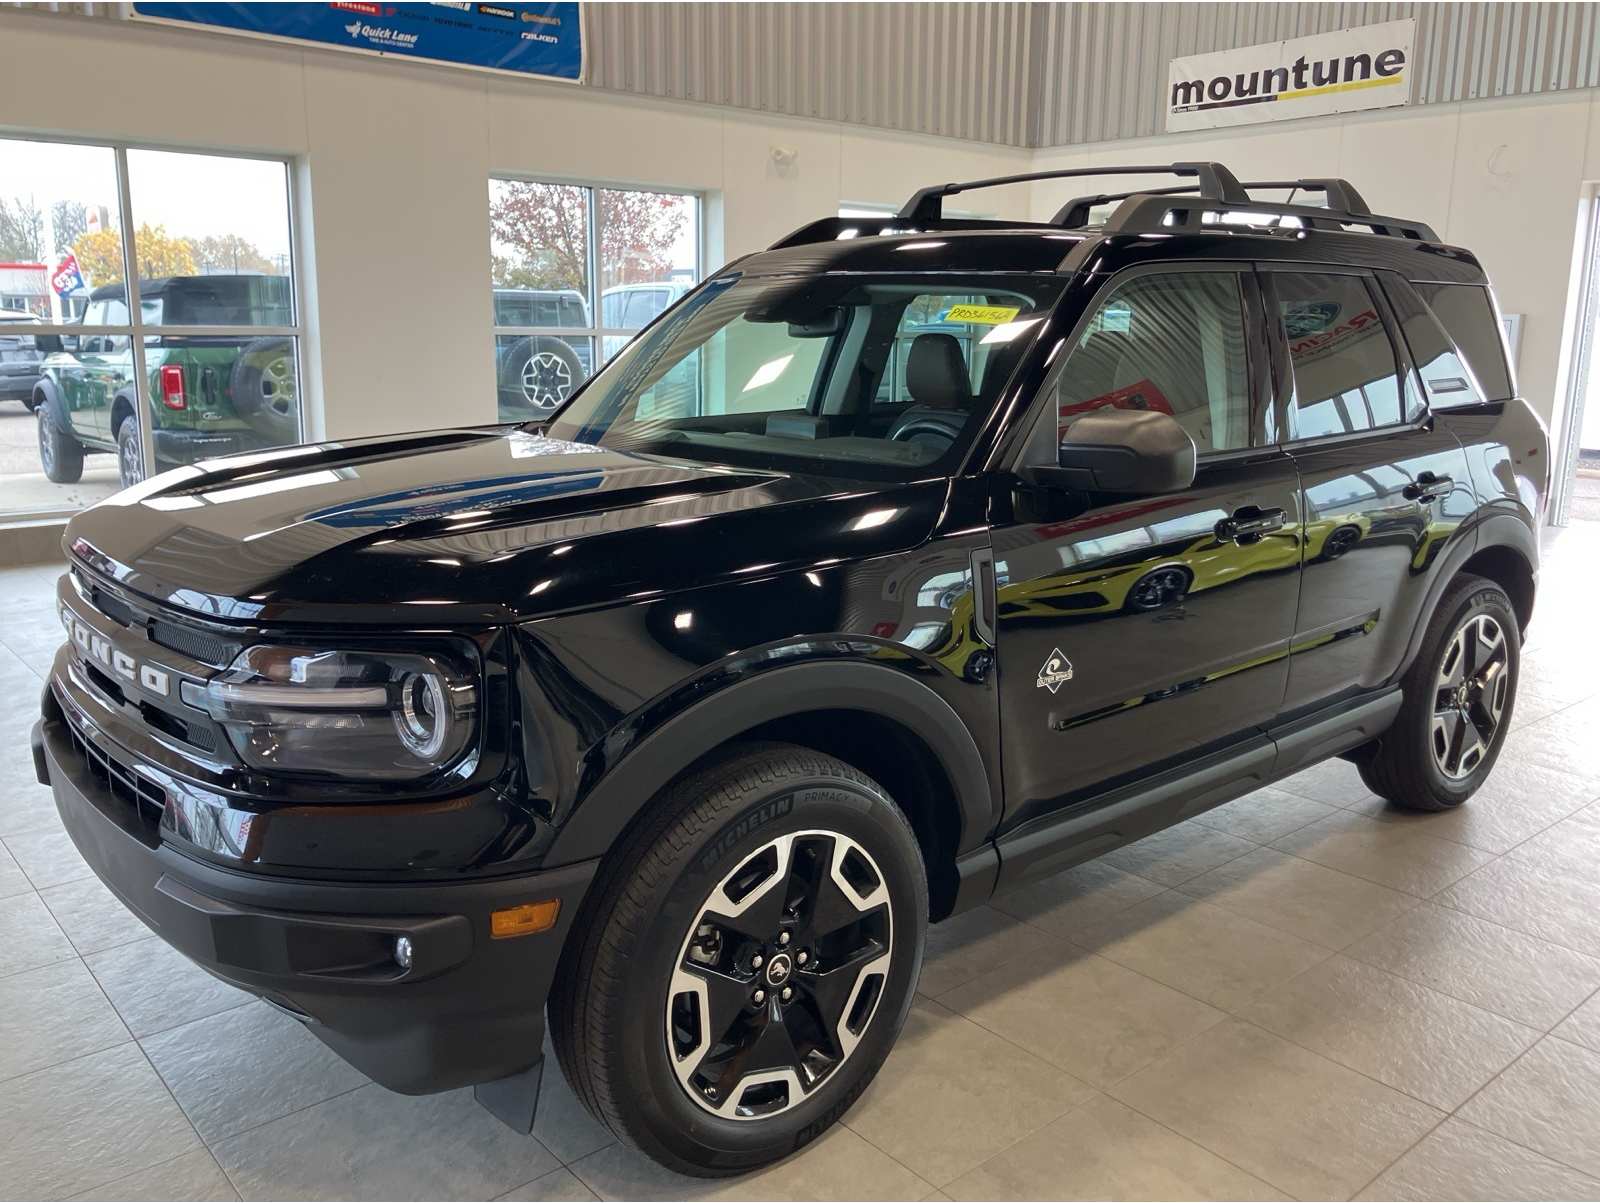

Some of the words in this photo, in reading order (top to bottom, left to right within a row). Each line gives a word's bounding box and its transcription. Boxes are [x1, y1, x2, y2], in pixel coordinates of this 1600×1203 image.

[361, 24, 391, 39] Quick
[391, 30, 419, 43] Lane
[521, 32, 558, 44] FALKEN
[1171, 48, 1406, 106] mountune
[702, 798, 791, 867] MICHELIN
[804, 791, 849, 802] PRIMACY
